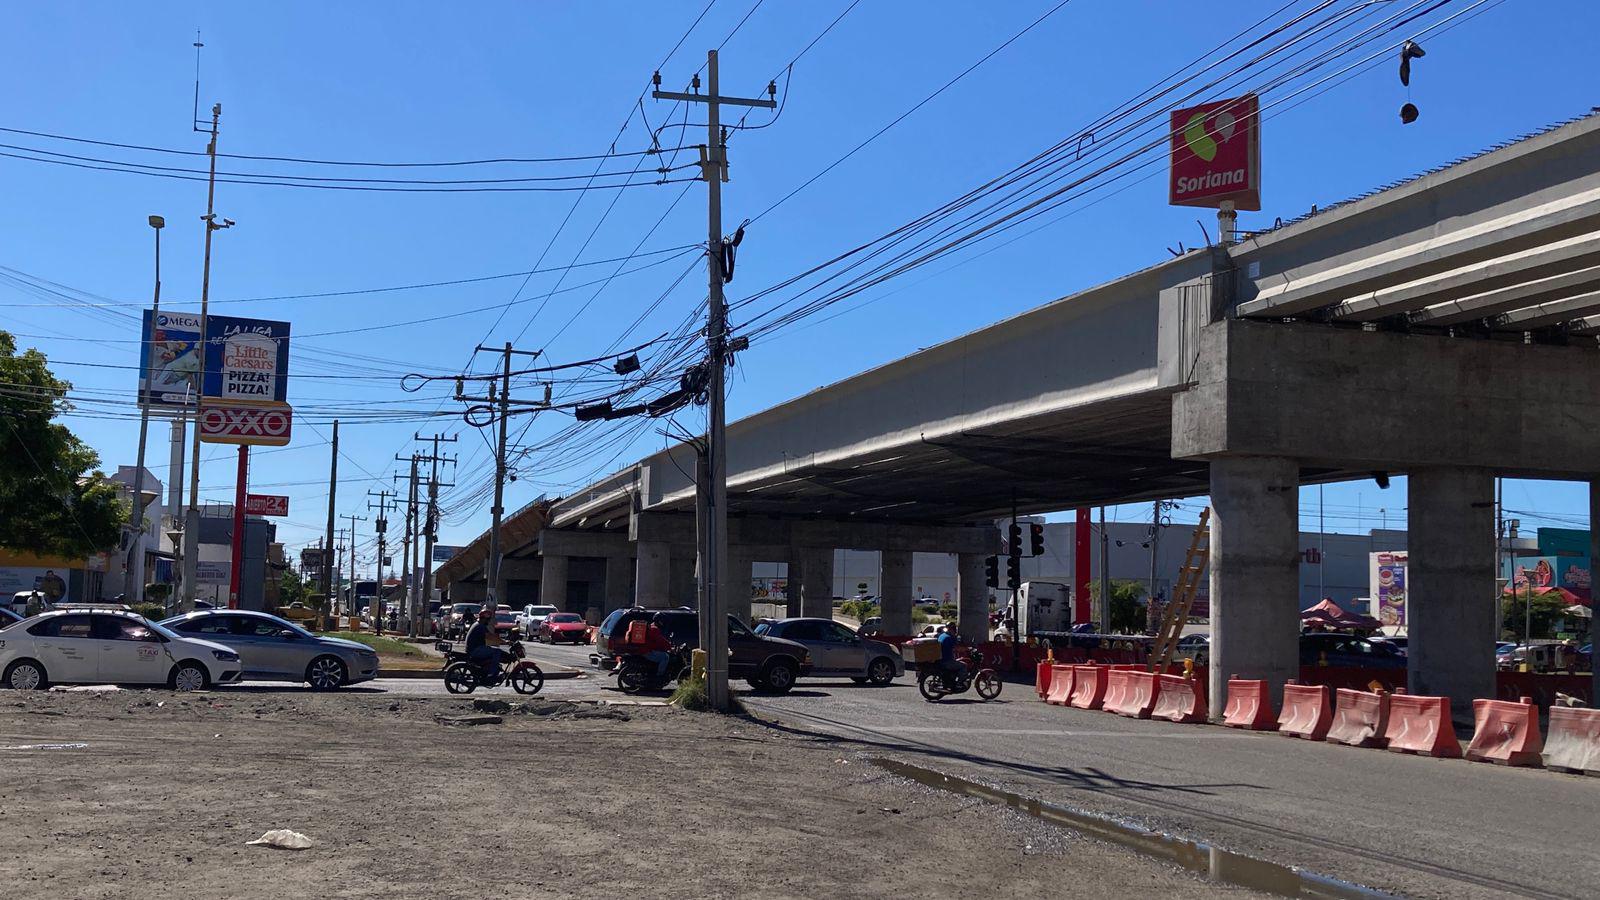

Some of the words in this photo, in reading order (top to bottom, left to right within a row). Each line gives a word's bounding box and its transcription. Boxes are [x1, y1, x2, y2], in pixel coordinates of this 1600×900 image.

[1176, 168, 1244, 194] Soriana
[224, 324, 240, 335] LA
[235, 346, 269, 359] Little
[225, 355, 273, 369] Caesars
[228, 370, 270, 383] PIZZA!
[228, 382, 269, 395] PIZZA!
[202, 410, 287, 435] OXXO
[267, 498, 286, 510] 24
